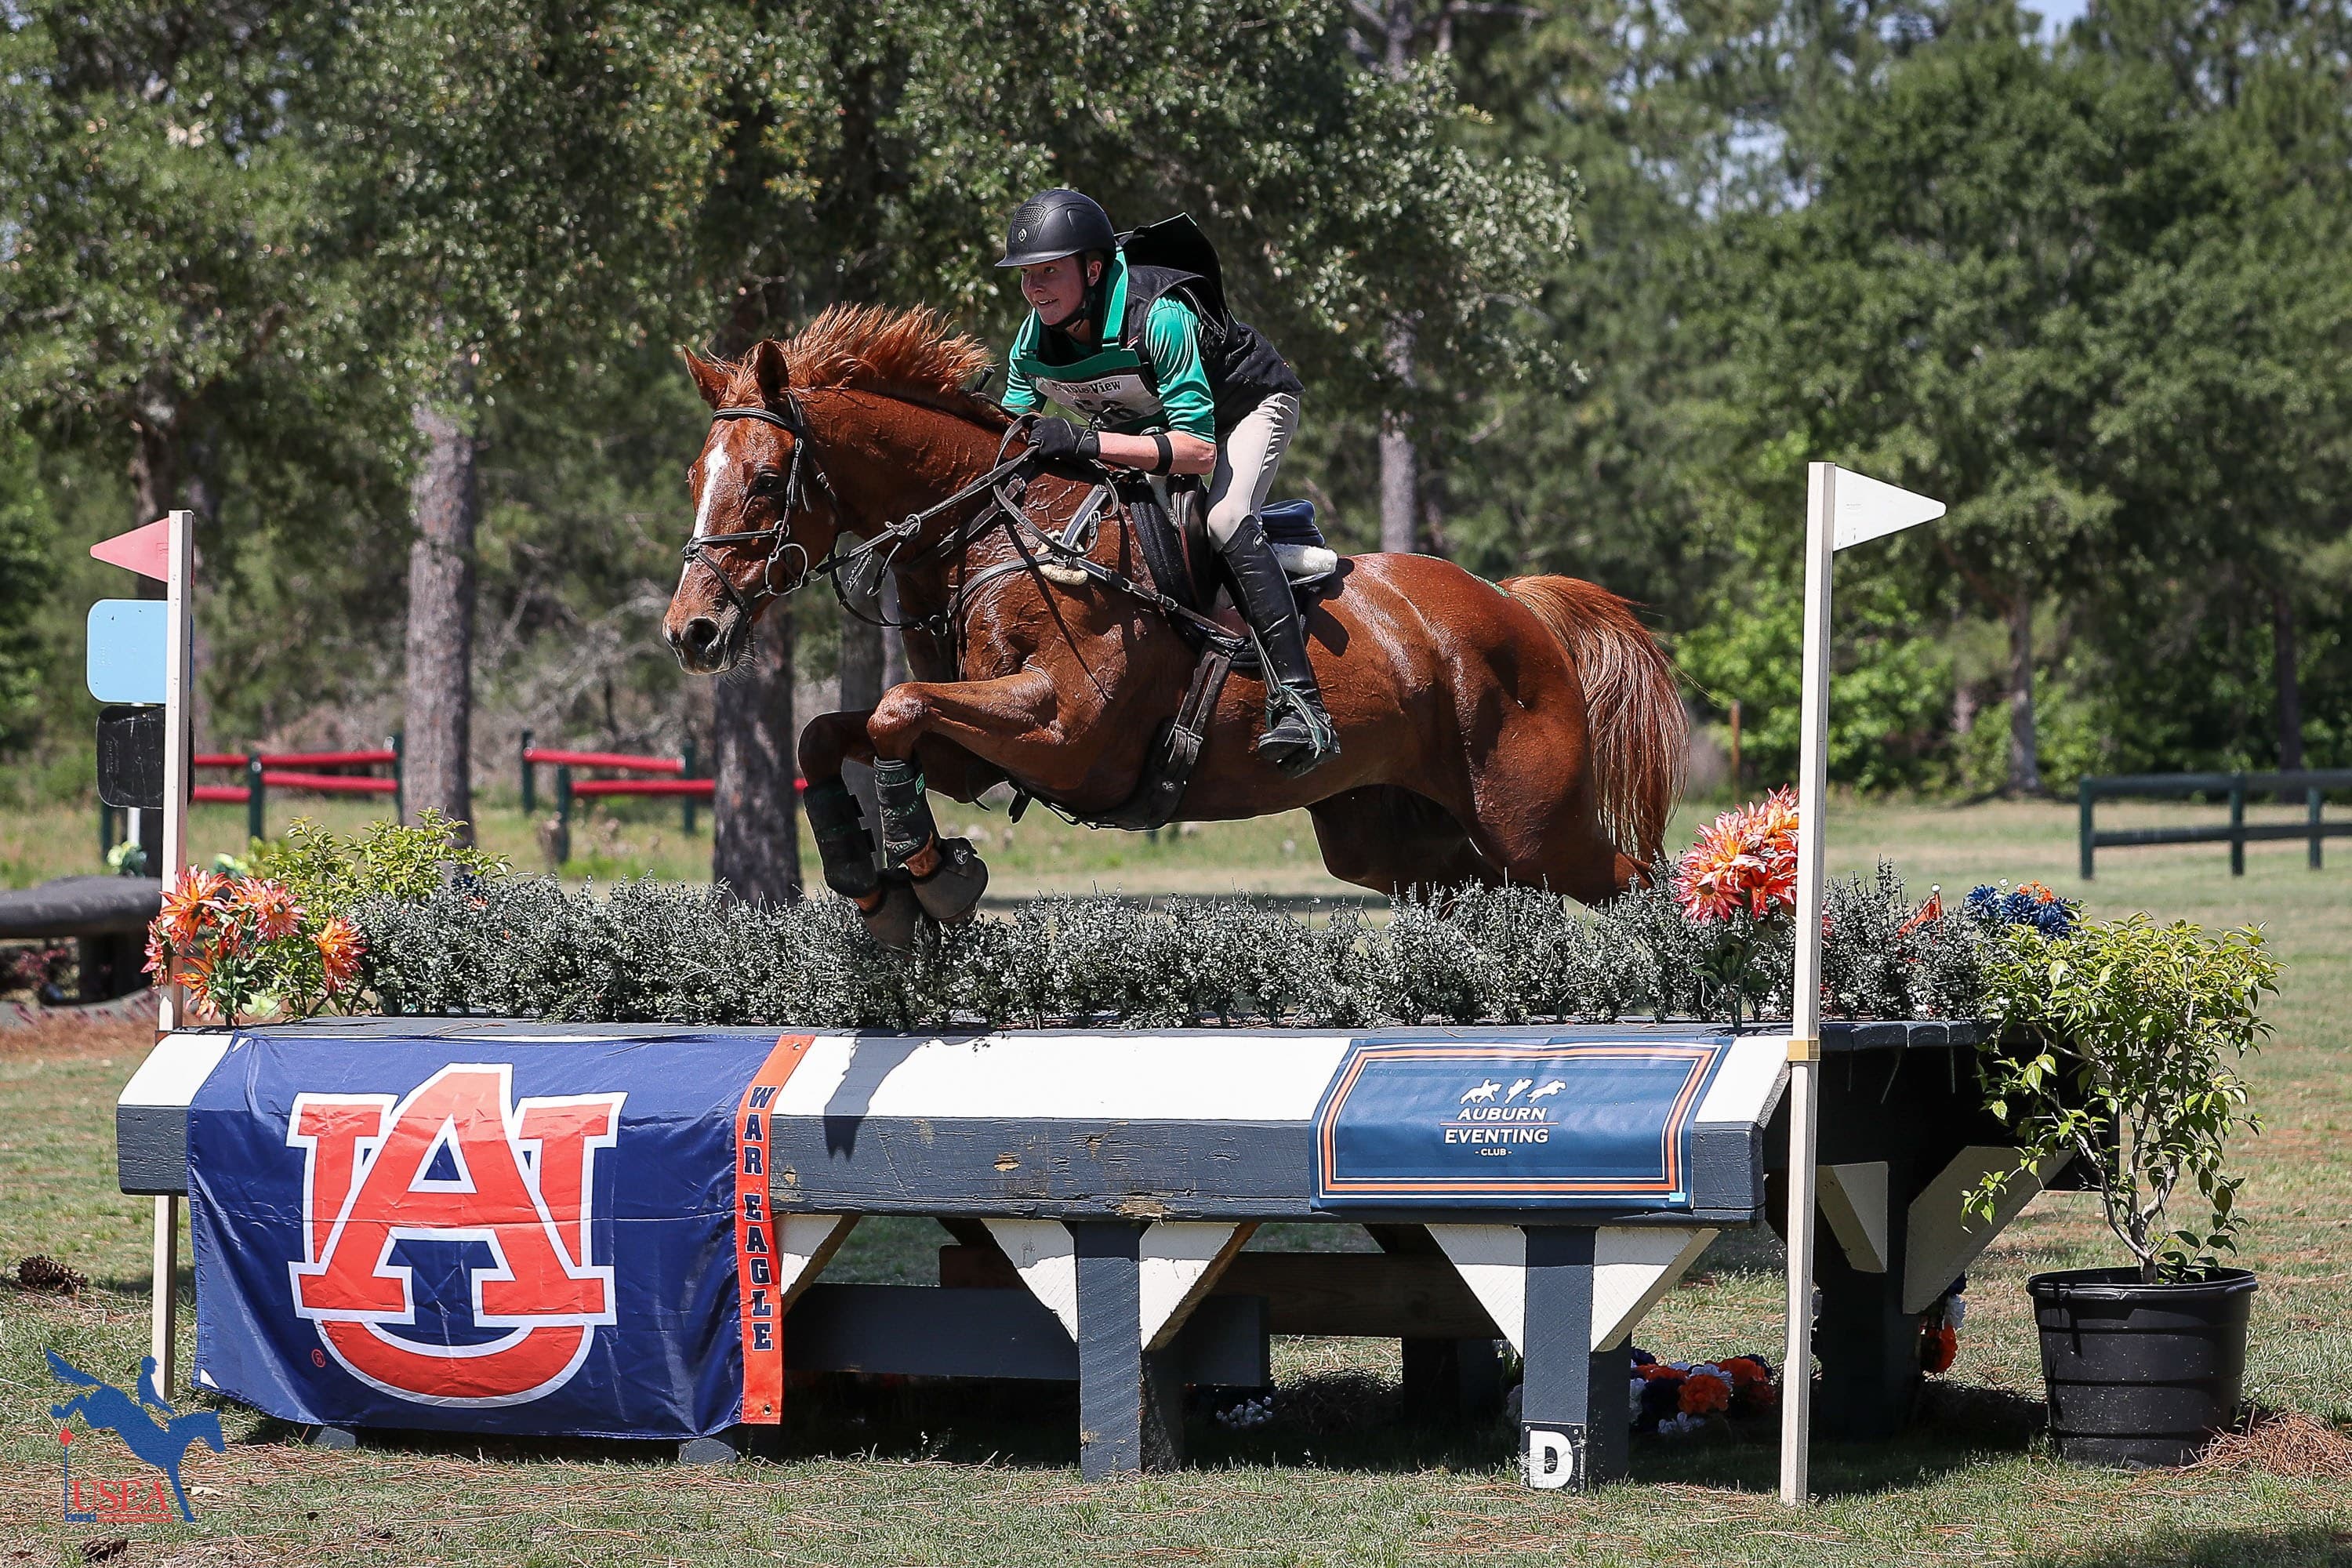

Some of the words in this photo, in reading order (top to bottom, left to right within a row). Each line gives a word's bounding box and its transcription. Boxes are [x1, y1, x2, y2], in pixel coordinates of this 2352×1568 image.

[744, 1085, 779, 1176] WAR
[1443, 1127, 1549, 1145] EVENTING
[1456, 1106, 1548, 1122] AUBURN
[742, 1192, 774, 1352] EAGLE
[1529, 1429, 1574, 1490] D
